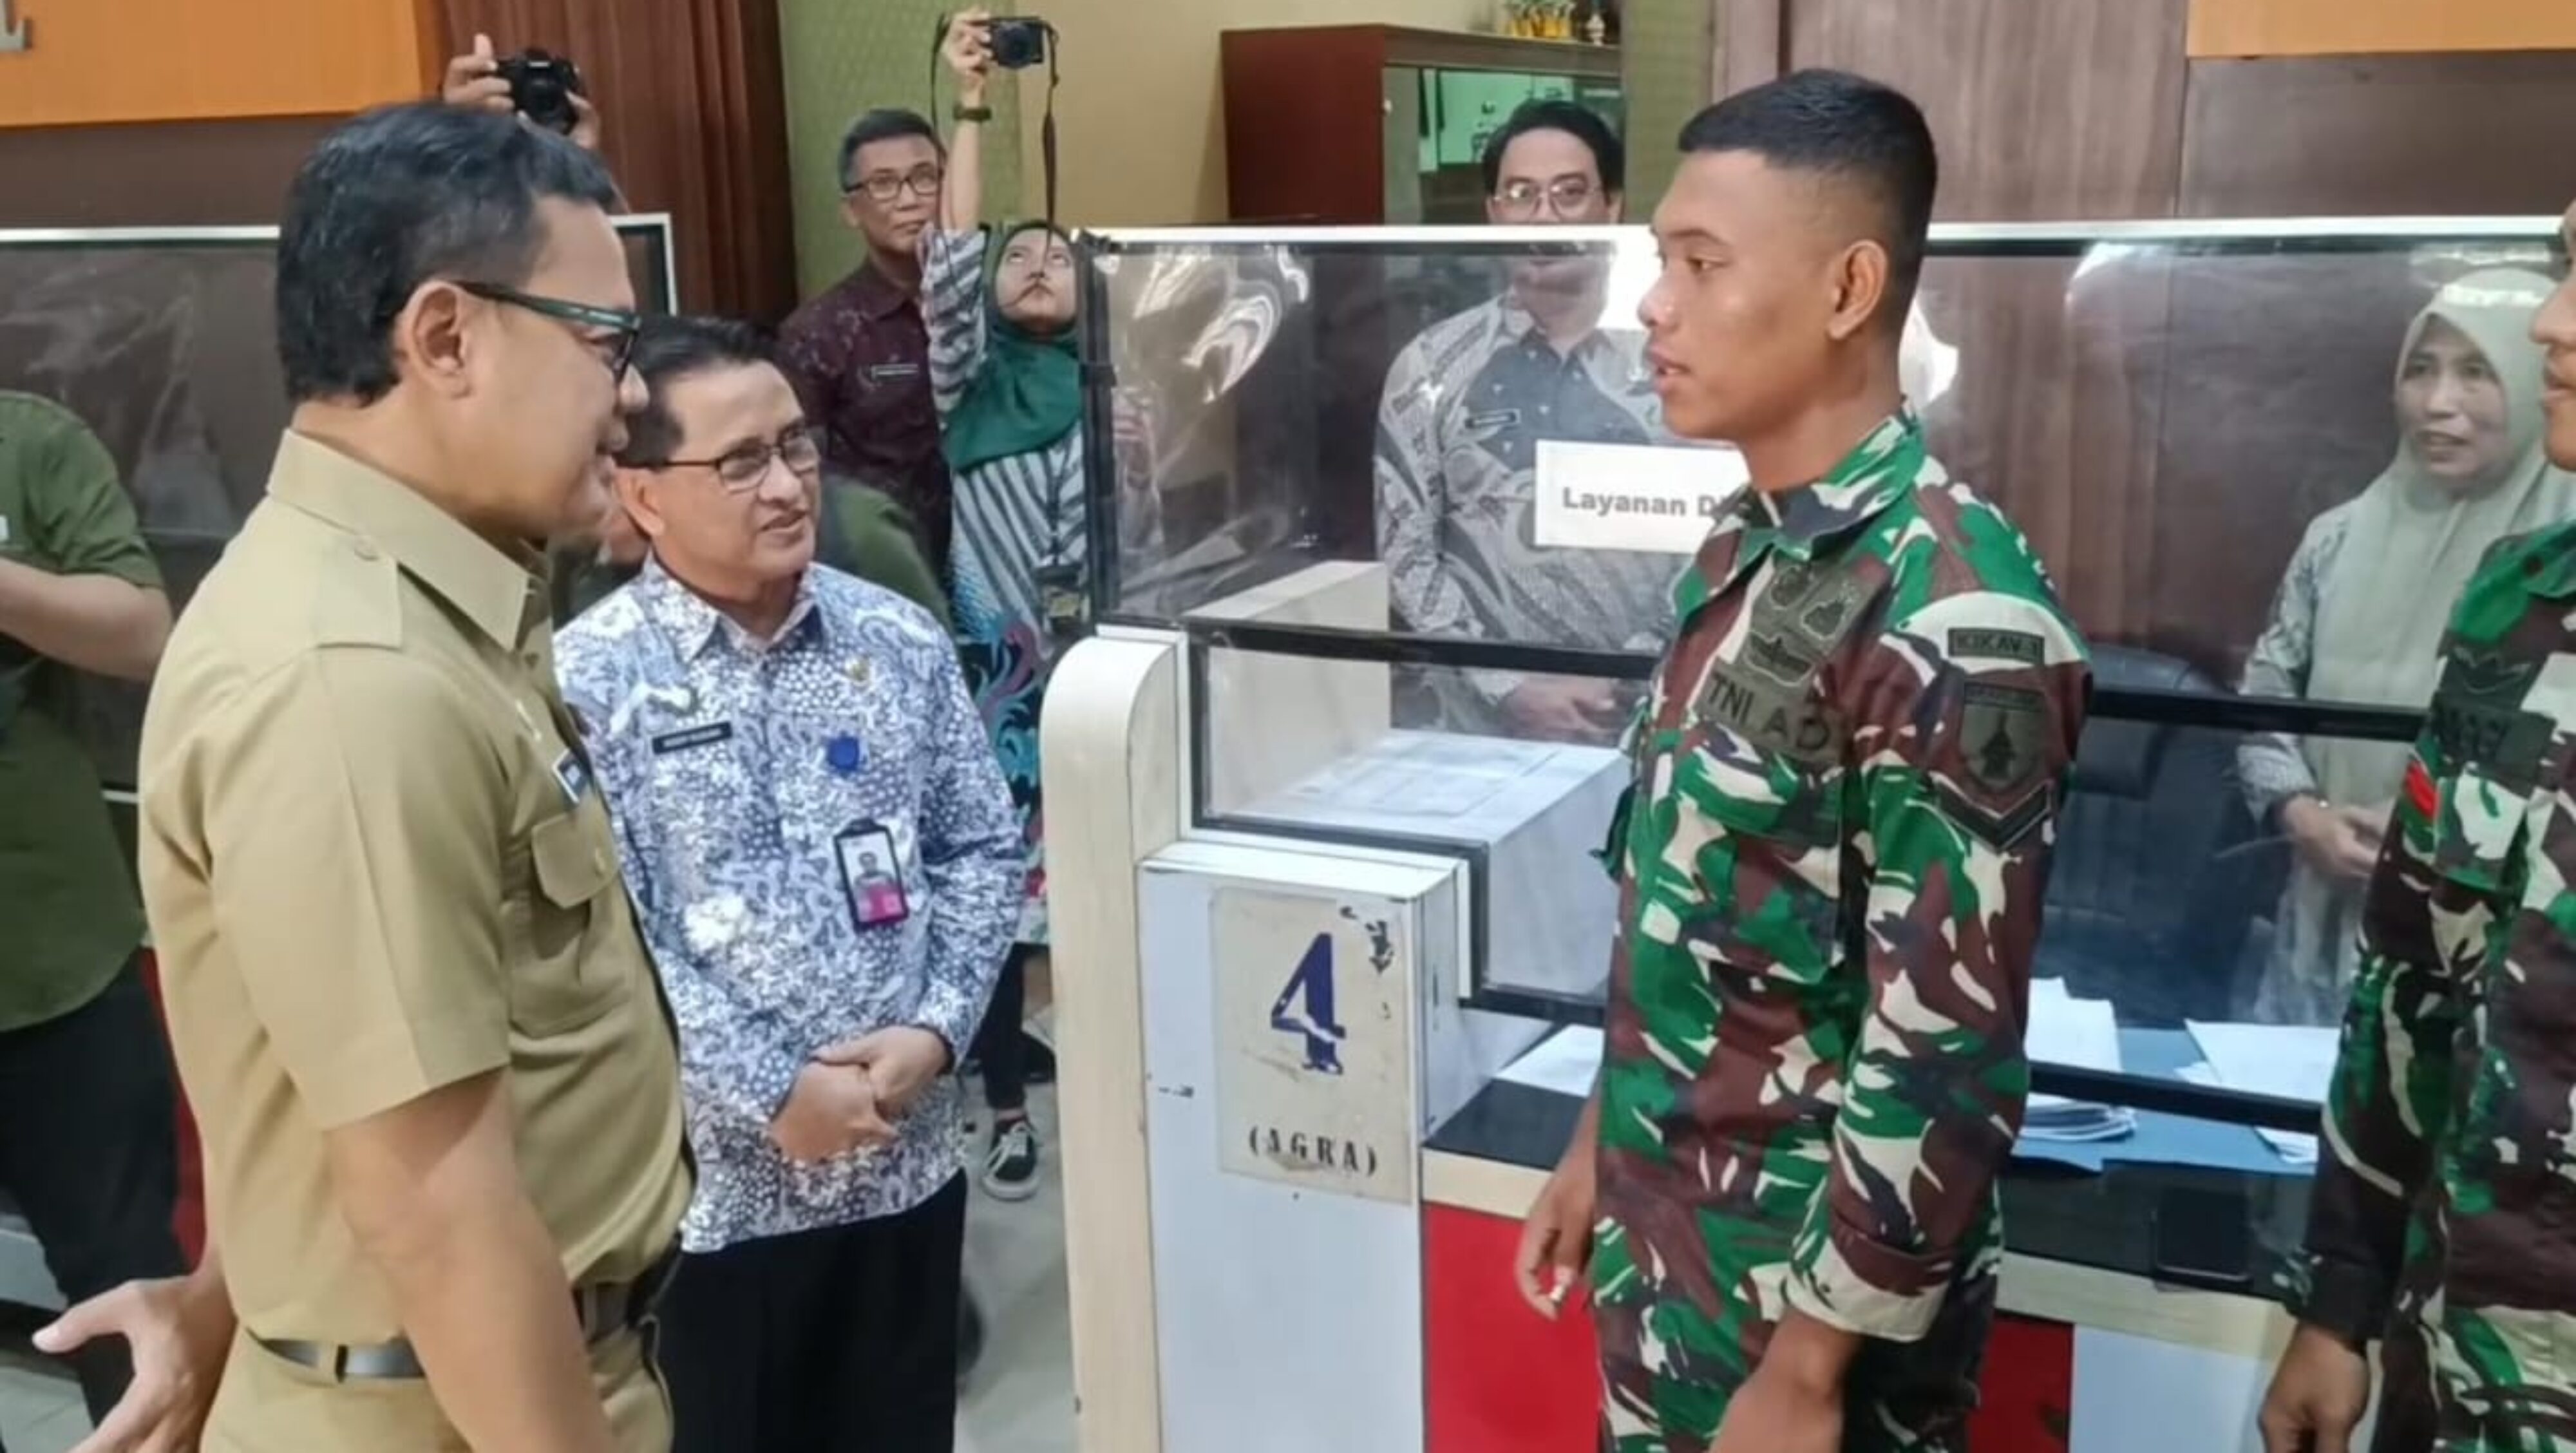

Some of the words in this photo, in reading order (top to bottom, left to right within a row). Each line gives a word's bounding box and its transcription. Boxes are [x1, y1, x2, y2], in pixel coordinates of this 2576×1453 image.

[1563, 487, 1686, 517] Layanan
[1709, 671, 1756, 725] TNI
[1271, 933, 1347, 1074] 4
[1249, 1125, 1377, 1177] (AGRA)
